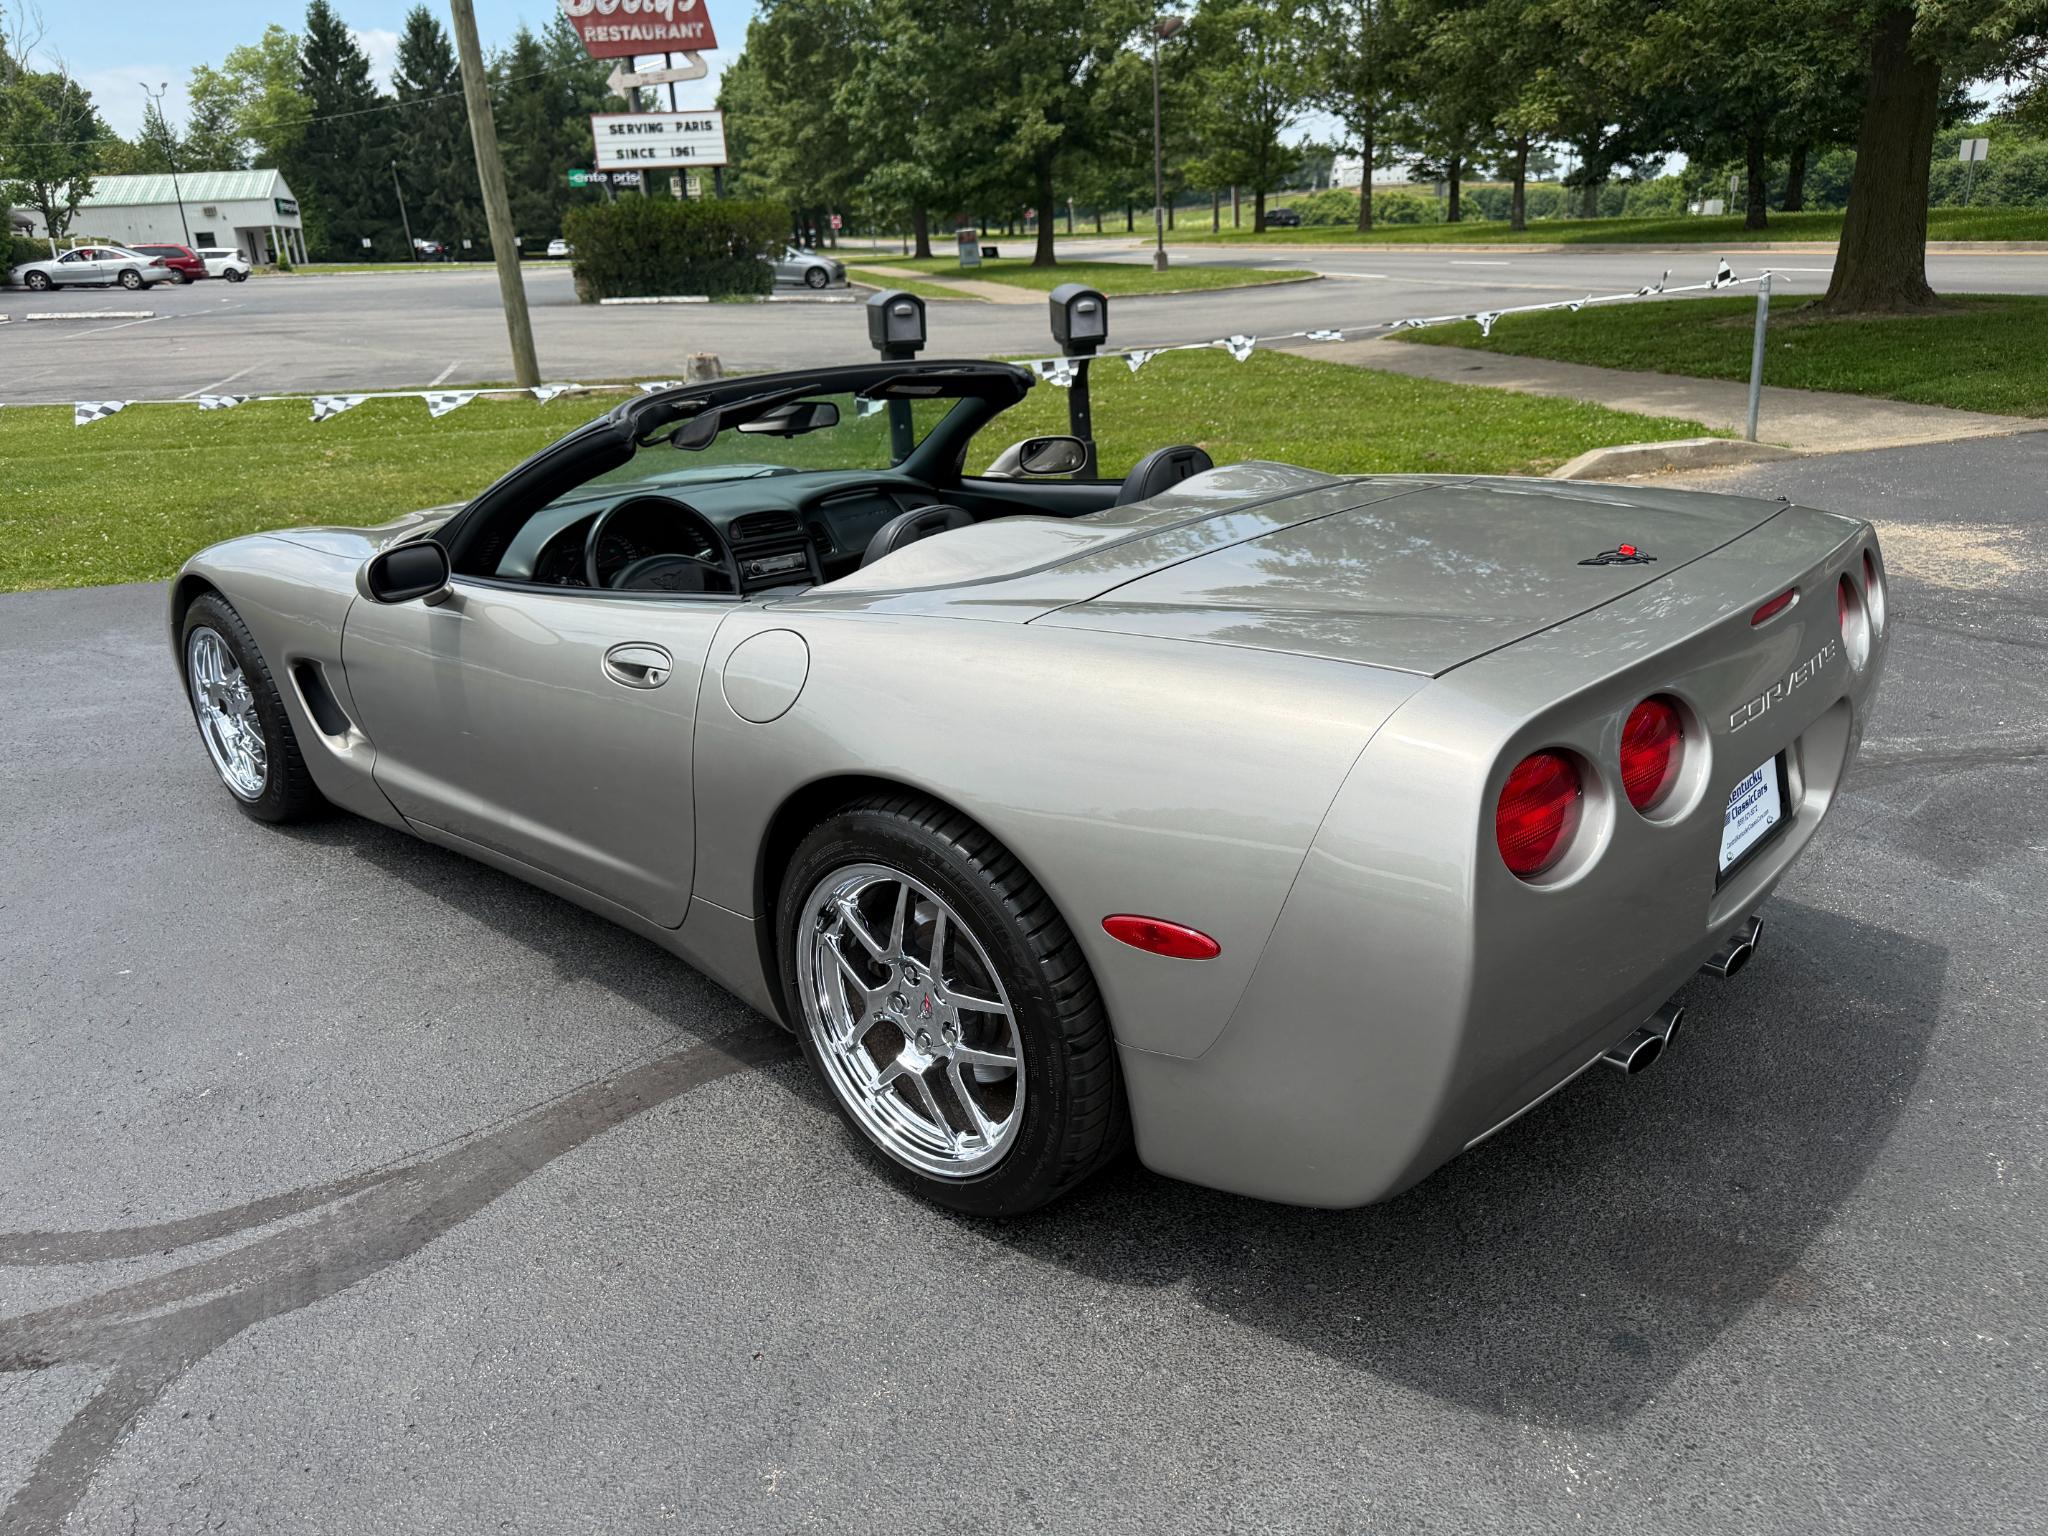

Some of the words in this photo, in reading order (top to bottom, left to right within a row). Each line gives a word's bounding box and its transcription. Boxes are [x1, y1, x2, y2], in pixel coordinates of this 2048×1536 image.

[583, 22, 704, 42] RESTAURANT
[609, 123, 664, 136] SERVING
[675, 120, 713, 133] PARIS
[616, 147, 656, 160] SINCE
[670, 145, 696, 158] 1961
[573, 171, 640, 185] entepris
[1730, 639, 1836, 733] CORVETTE
[1731, 783, 1768, 820] ClassicCars
